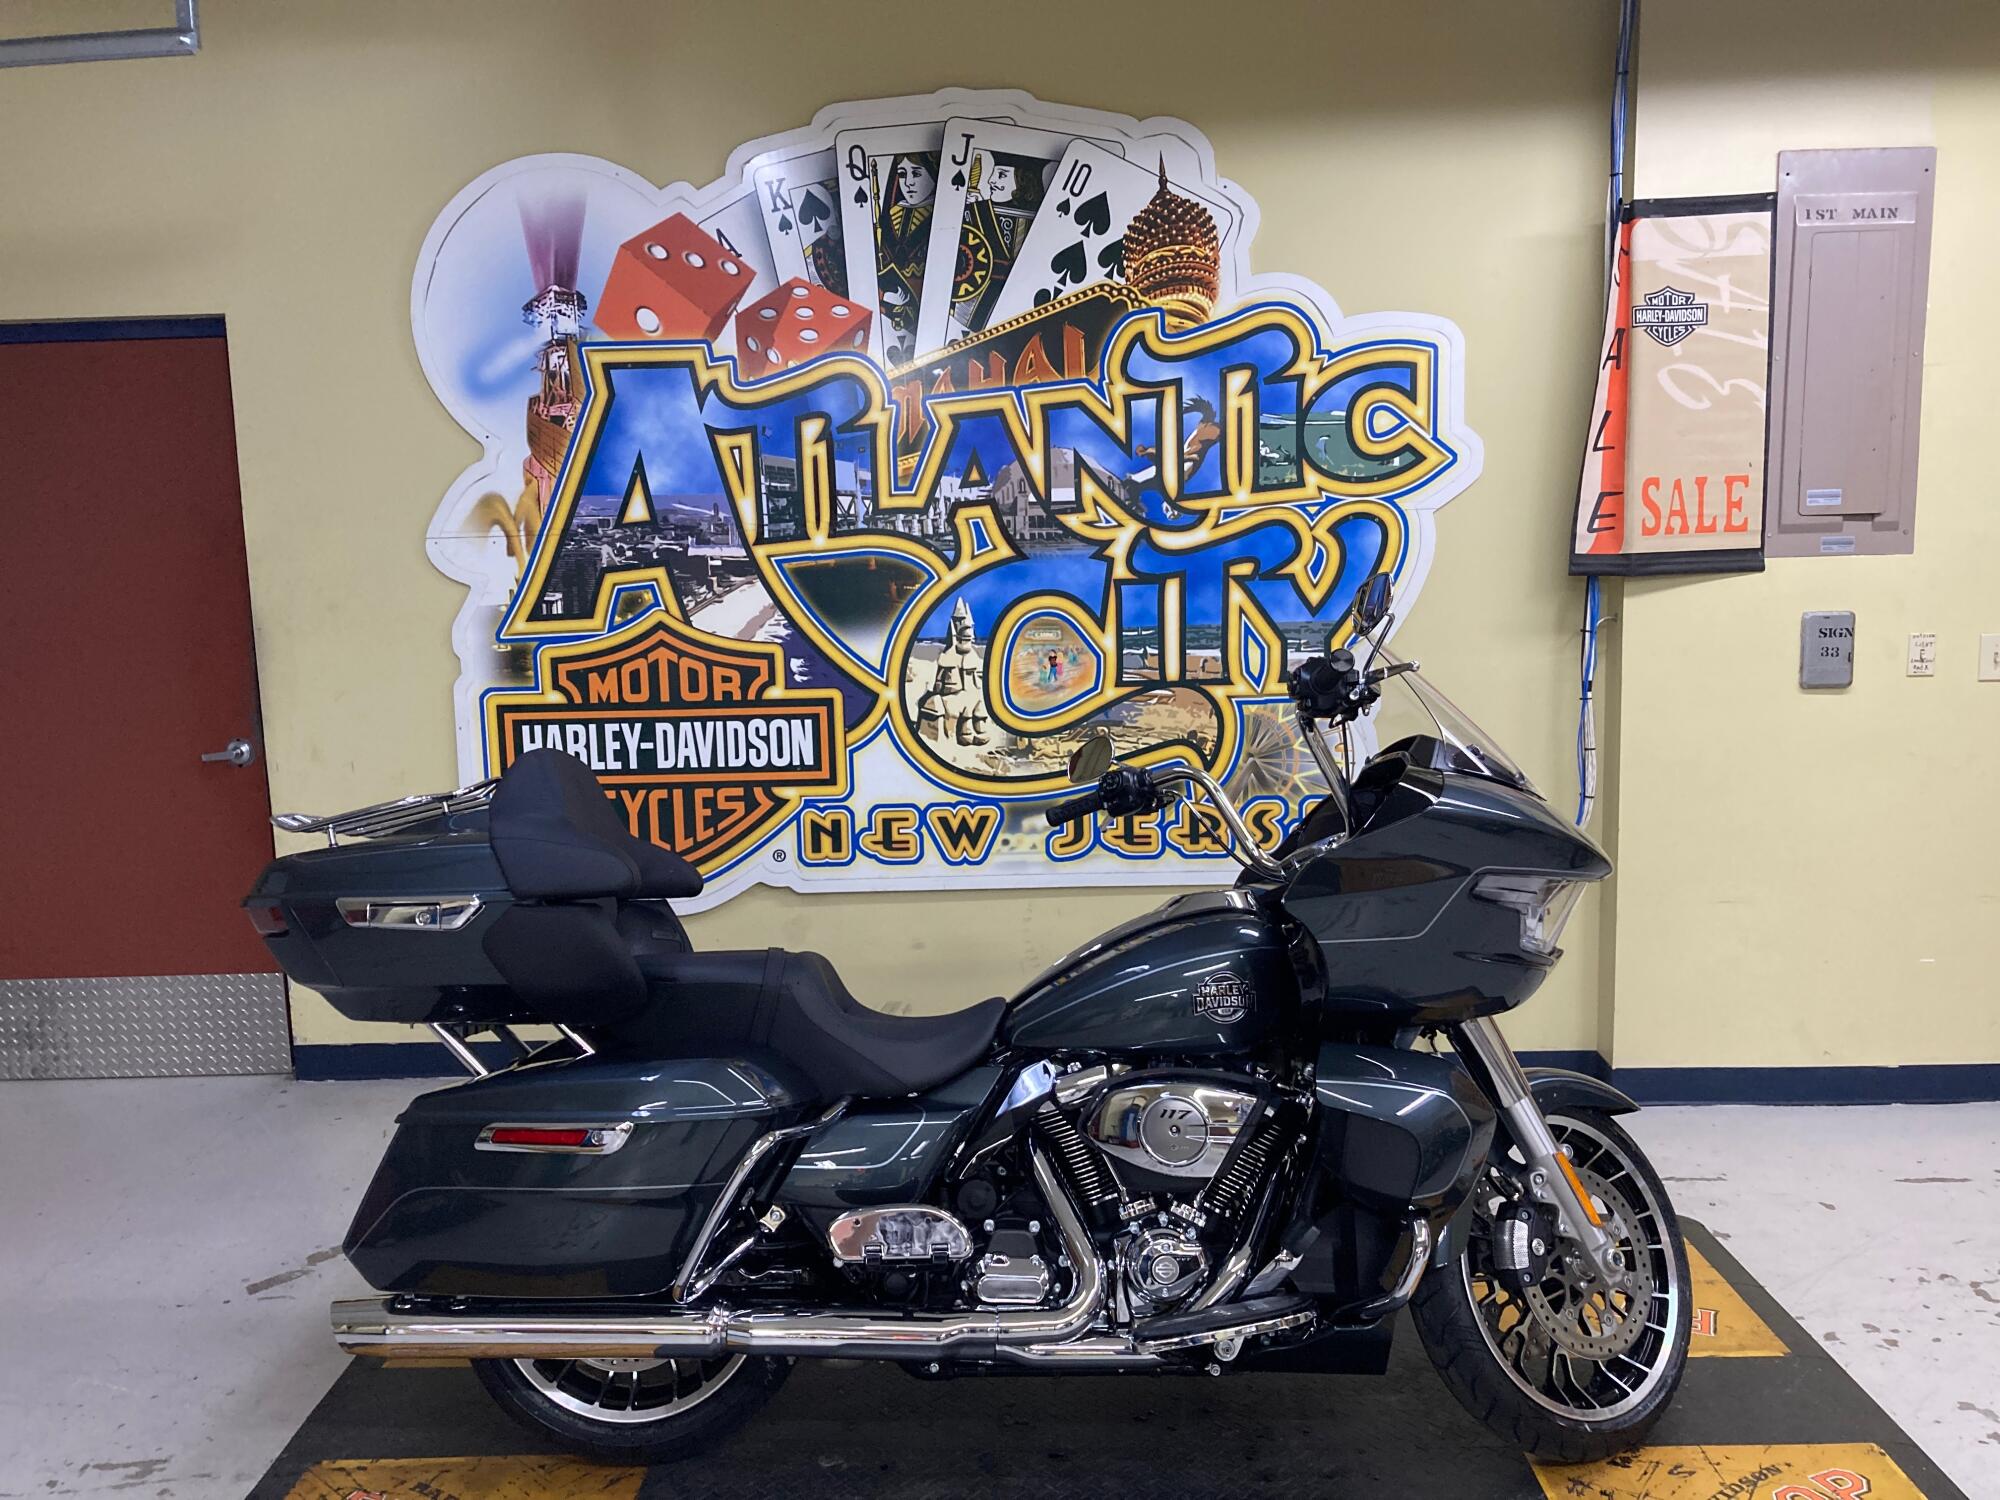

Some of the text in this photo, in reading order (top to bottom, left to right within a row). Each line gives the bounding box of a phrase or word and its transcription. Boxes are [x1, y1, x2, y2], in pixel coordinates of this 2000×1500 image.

[1852, 207, 1899, 219] MAIN
[1651, 291, 1686, 306] MOTOR
[1636, 308, 1703, 323] HARLEY-DAVIDSON
[1652, 326, 1686, 342] CYCLES
[502, 305, 1456, 722] ATLANTIC
[1641, 475, 1750, 537] SALE
[1818, 627, 1854, 639] SIGN
[885, 505, 1408, 792] CITY
[1820, 646, 1840, 658] 33
[588, 646, 742, 704] MOTOR
[522, 719, 815, 770] HARLEY-DAVIDSON
[604, 786, 746, 852] YCLES
[805, 806, 1308, 861] NEW JERS
[1201, 985, 1245, 996] HARLEY
[1160, 1109, 1193, 1119] 117
